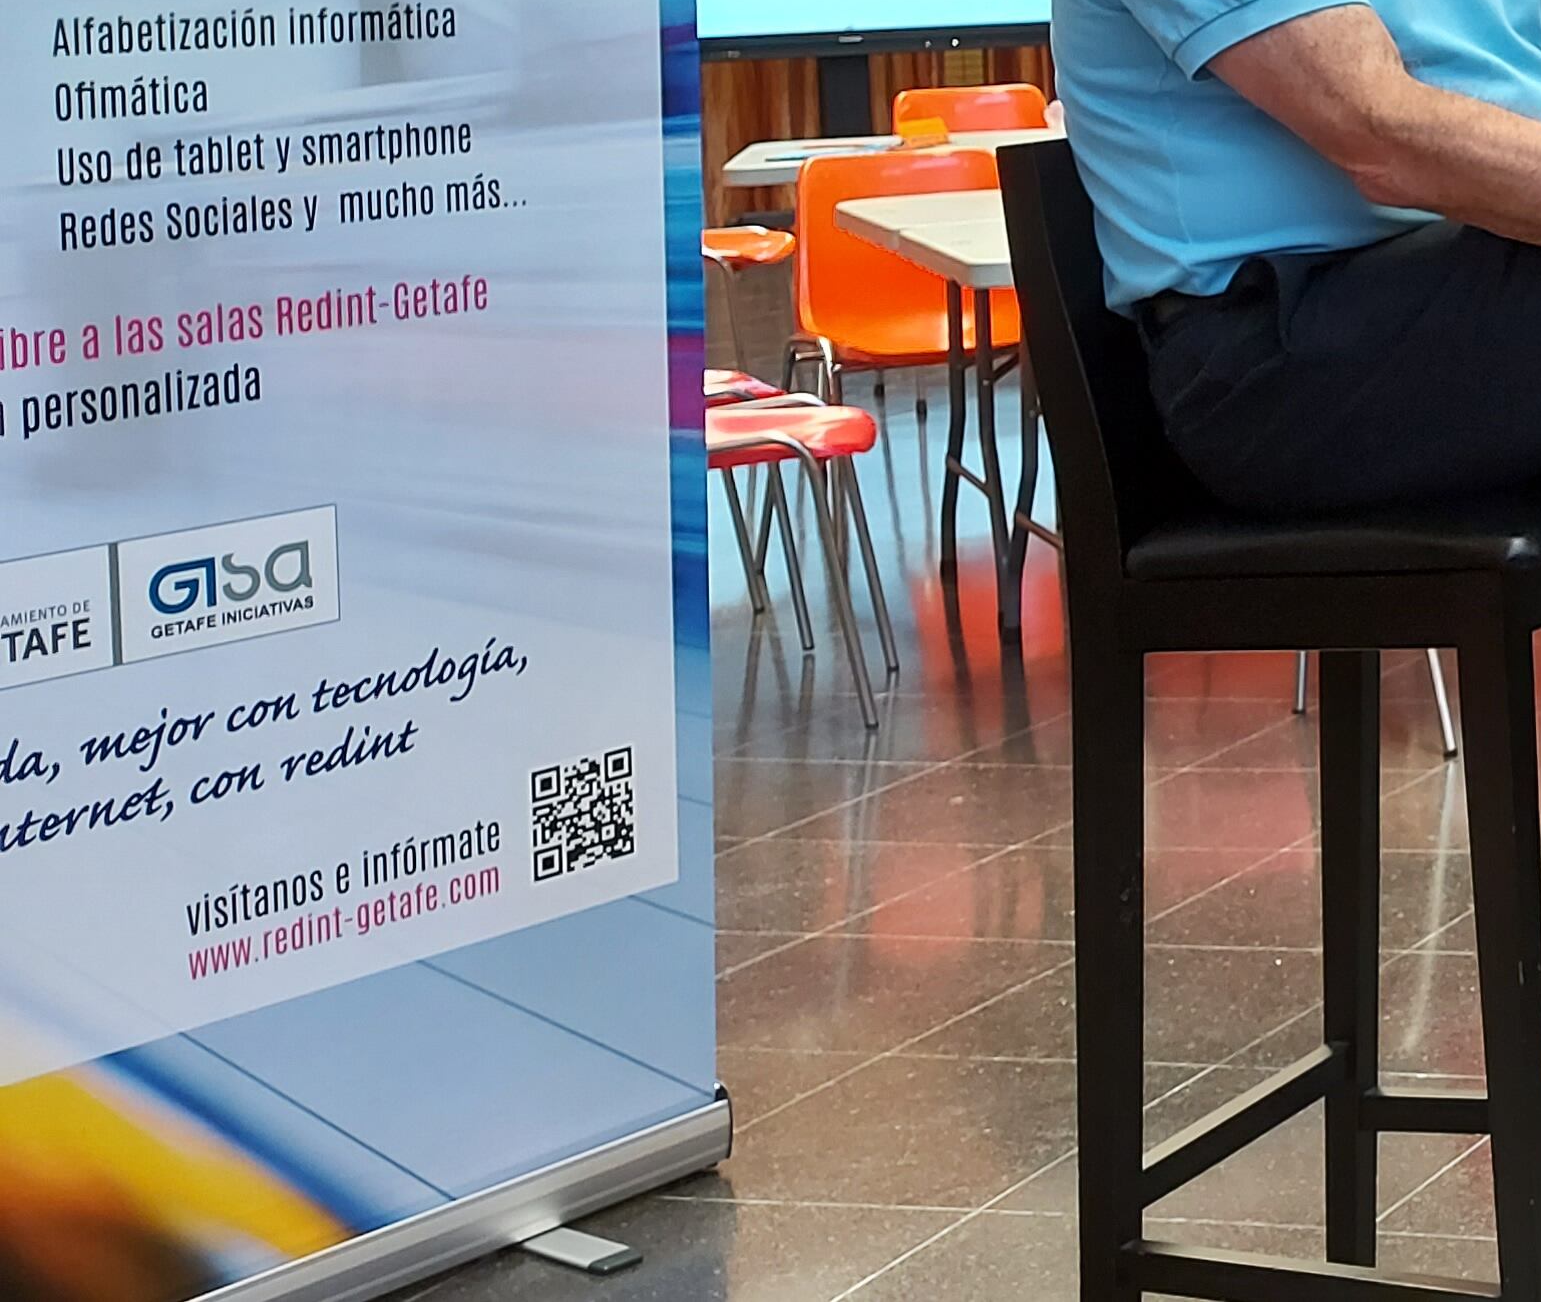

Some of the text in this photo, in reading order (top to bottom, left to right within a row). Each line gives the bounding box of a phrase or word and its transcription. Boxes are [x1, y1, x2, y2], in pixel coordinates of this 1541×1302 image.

[52, 3, 456, 57] Alfabetización informática
[55, 76, 209, 122] Ofimática
[57, 121, 472, 186] Uso de tablet y smartphone
[60, 174, 528, 251] Redes Sociales y mucho más...
[83, 324, 99, 359] a
[115, 314, 164, 358] las
[178, 302, 264, 349] salas
[276, 274, 489, 336] Redint-Getafe
[22, 365, 262, 440] personalizada
[1, 617, 92, 663] TAFE
[73, 599, 91, 614] DE
[151, 595, 314, 640] GETAFE INICIATIVAS
[80, 707, 216, 772] mejor
[226, 693, 299, 731] con
[312, 637, 529, 712] tecnología,
[190, 769, 265, 808] con
[280, 720, 419, 781] redint
[186, 818, 501, 937] visítanos e infórmate
[188, 864, 501, 982] www.redint-getafe.com
